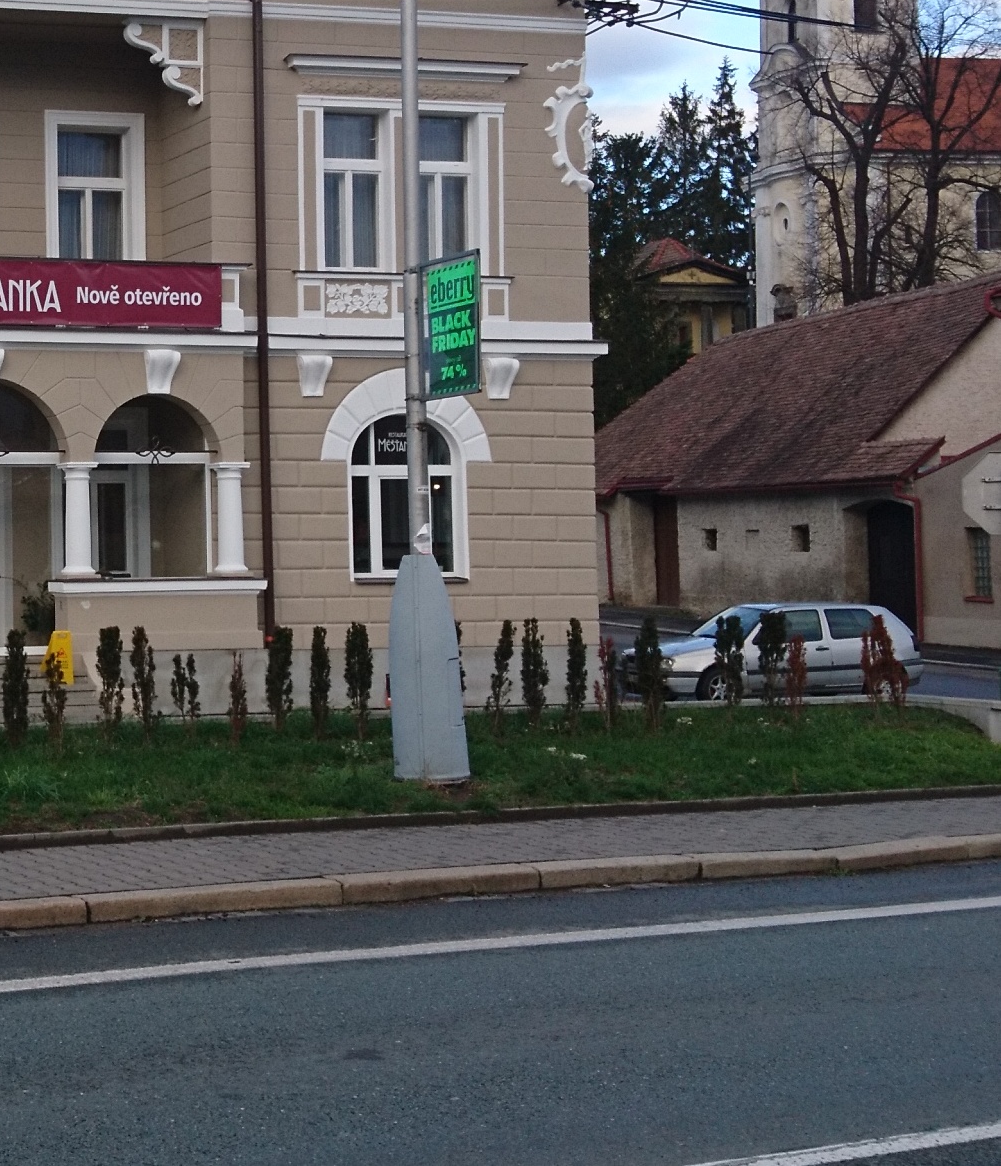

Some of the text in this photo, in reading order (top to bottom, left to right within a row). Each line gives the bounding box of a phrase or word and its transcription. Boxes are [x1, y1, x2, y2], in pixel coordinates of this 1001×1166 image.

[76, 285, 120, 305] Nově
[124, 286, 203, 306] otevřeno
[430, 274, 475, 304] eberry
[431, 309, 472, 334] BLACK
[432, 328, 476, 353] FRIDAY
